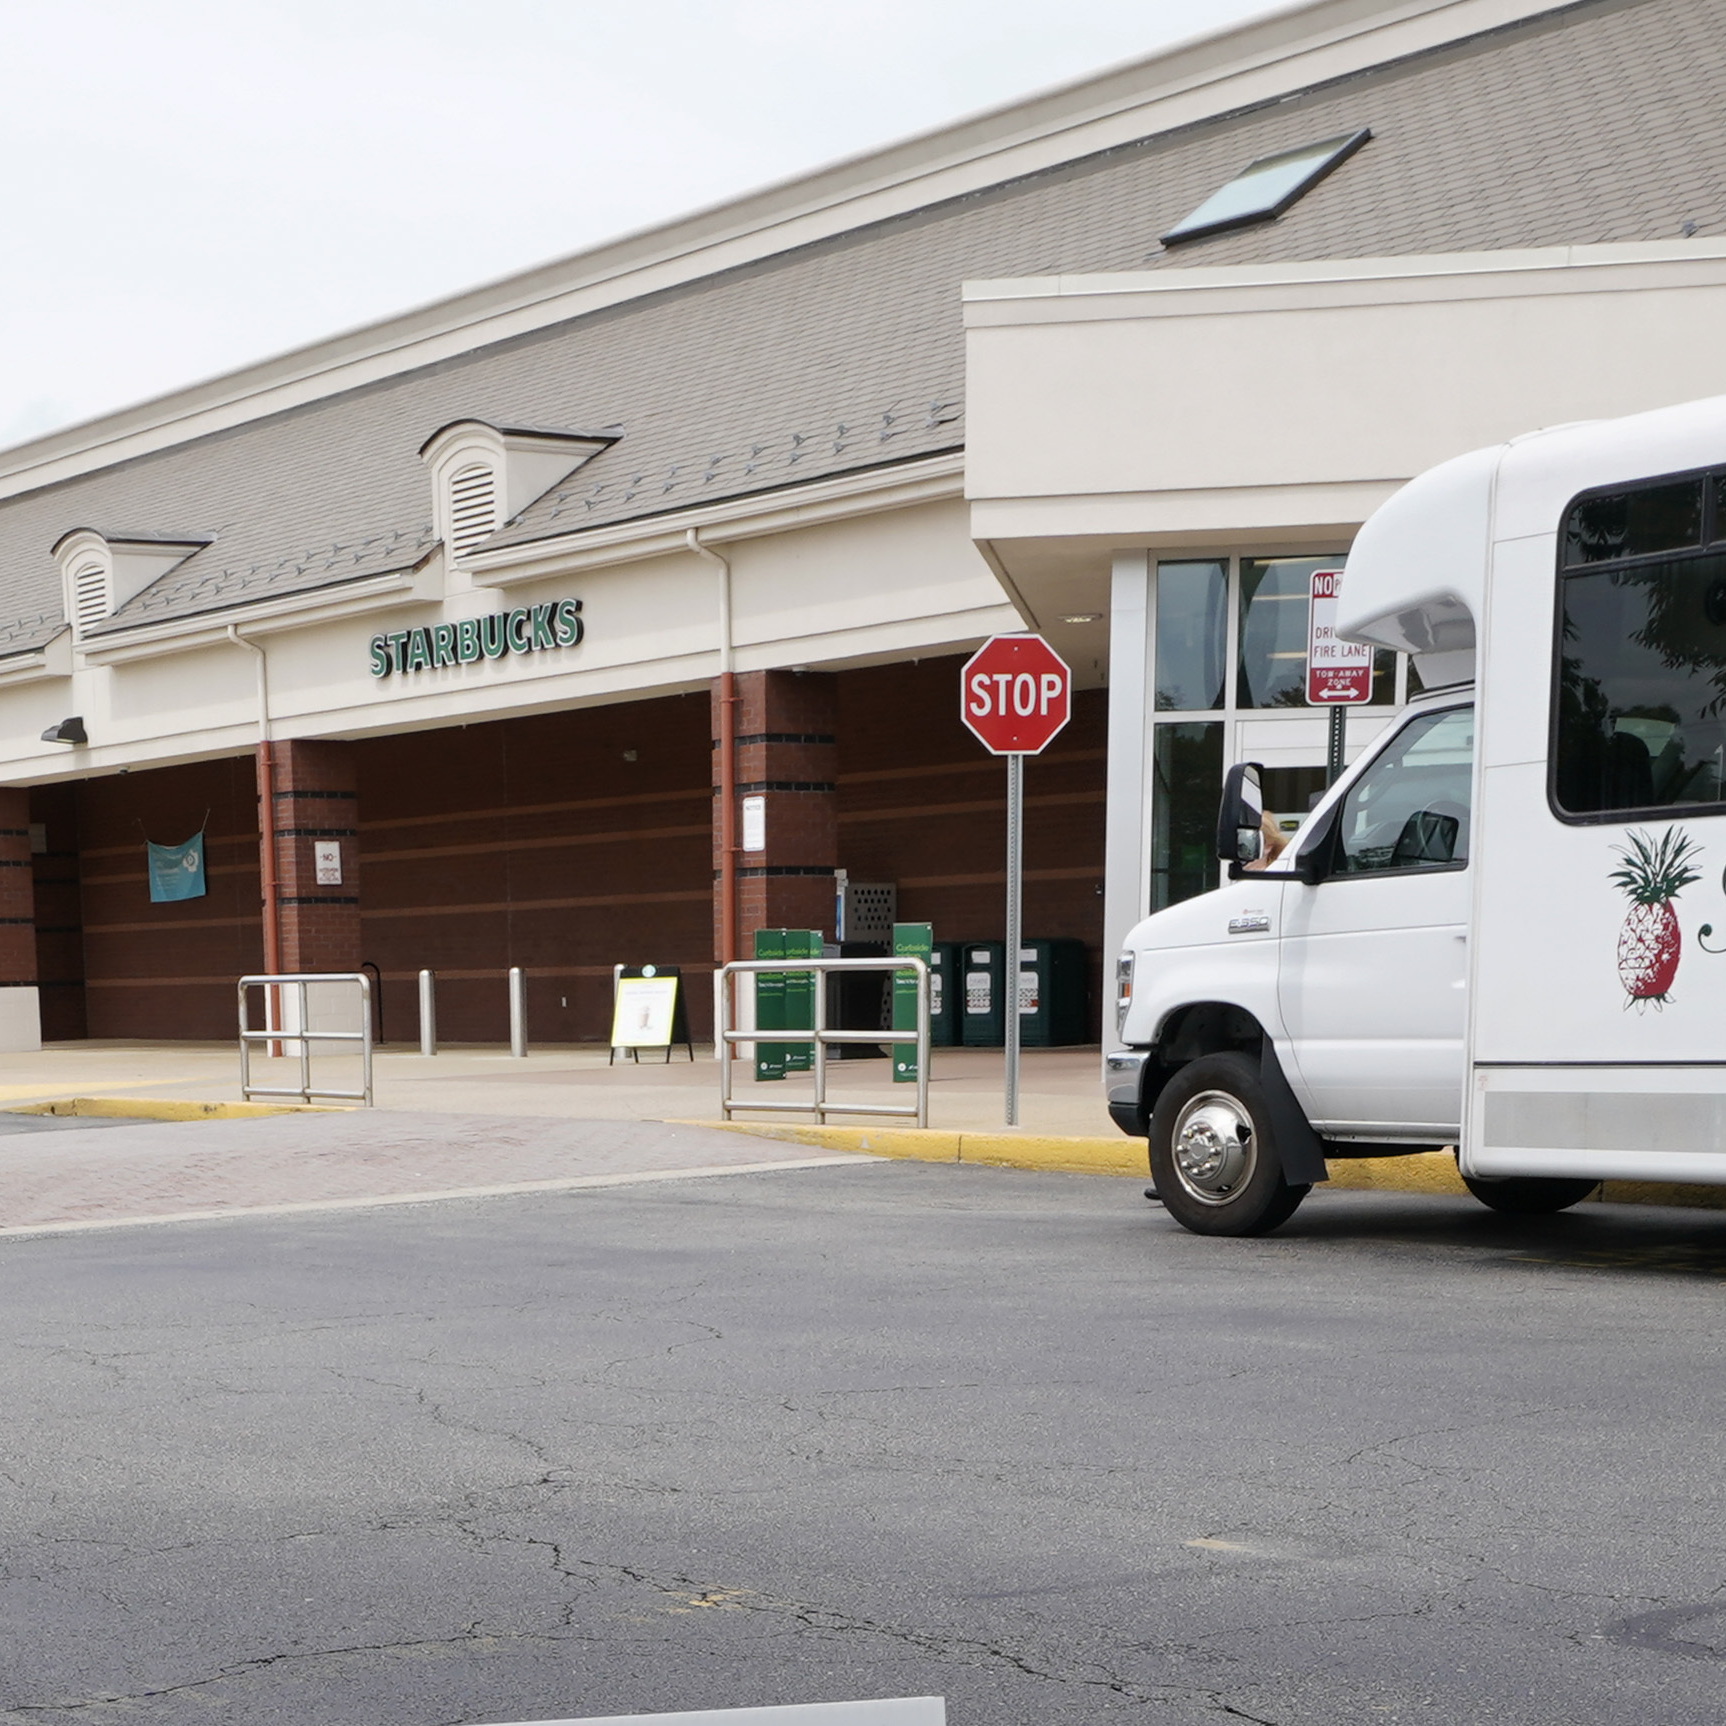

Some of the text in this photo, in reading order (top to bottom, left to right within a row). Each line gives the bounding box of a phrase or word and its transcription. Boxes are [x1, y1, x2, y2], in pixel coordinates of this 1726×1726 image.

[1314, 575, 1333, 596] NO
[369, 598, 580, 678] STARBUCKS
[1314, 644, 1368, 658] FIRE LANE
[1316, 669, 1364, 679] TOW-AWAY
[1327, 678, 1352, 687] ZONE
[969, 672, 1063, 717] STOP
[895, 943, 930, 952] Curbside
